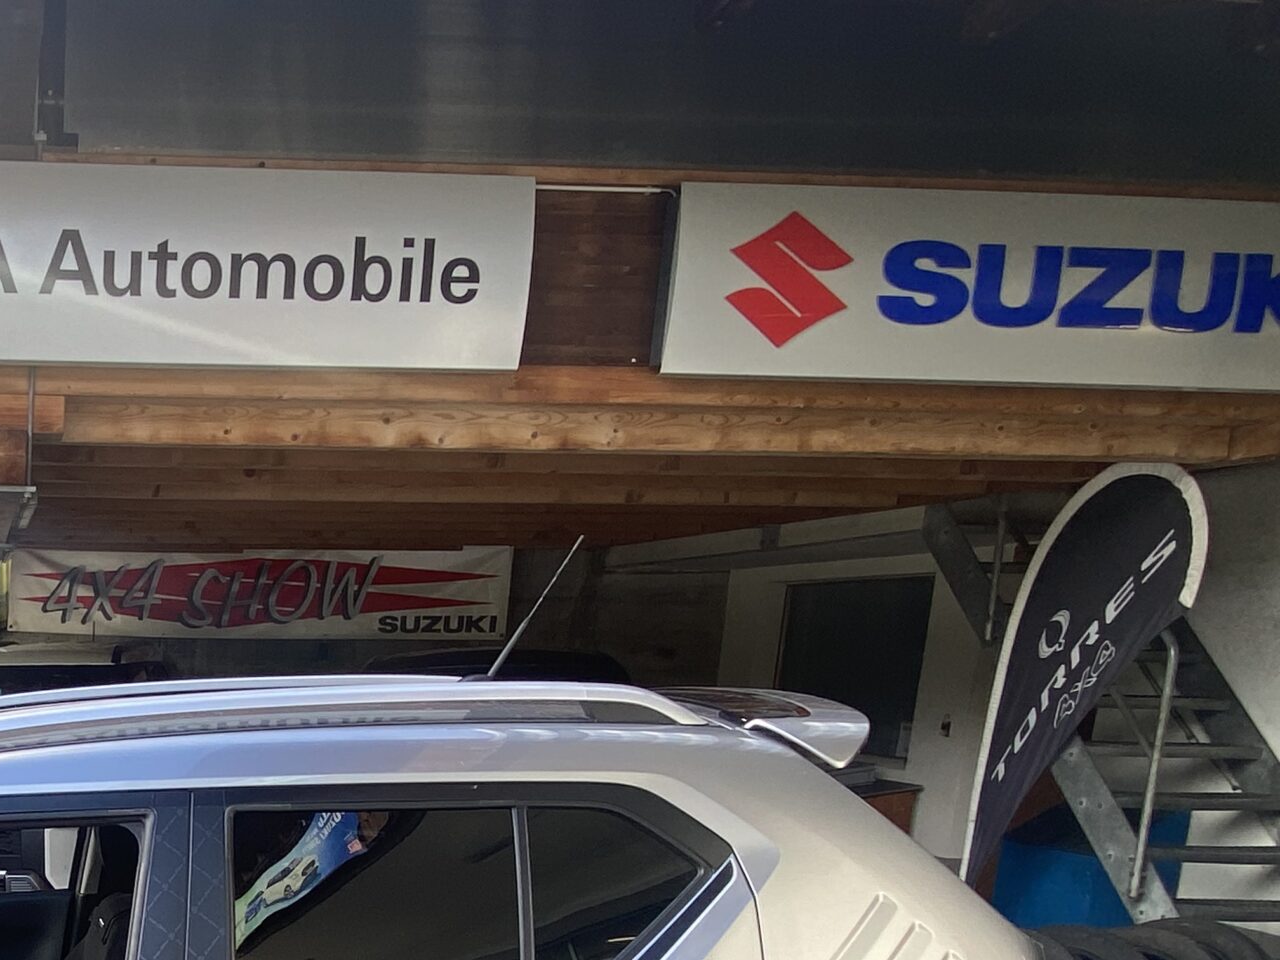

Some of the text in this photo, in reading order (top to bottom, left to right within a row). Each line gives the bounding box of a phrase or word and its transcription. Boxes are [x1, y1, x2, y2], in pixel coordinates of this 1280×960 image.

[40, 229, 482, 305] Automobile
[177, 554, 384, 628] SHOW
[378, 613, 497, 634] SUZUKI
[991, 529, 1177, 784] TORRES
